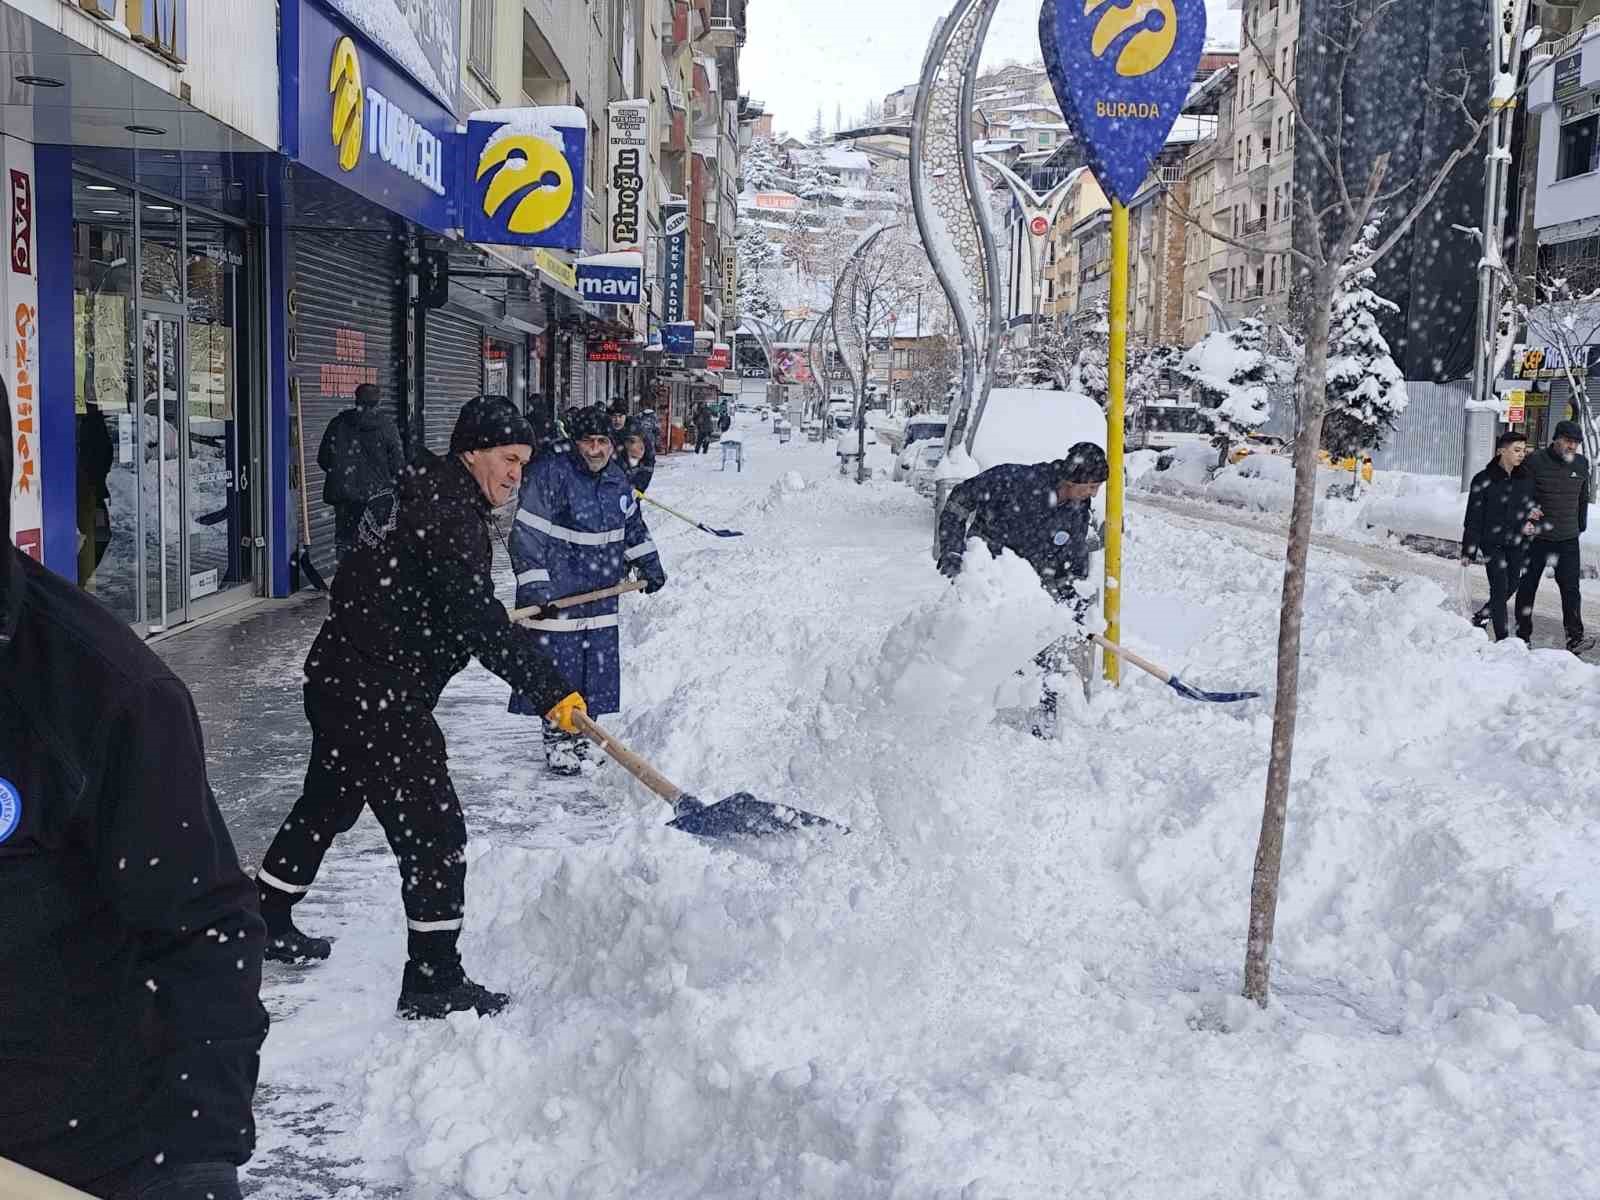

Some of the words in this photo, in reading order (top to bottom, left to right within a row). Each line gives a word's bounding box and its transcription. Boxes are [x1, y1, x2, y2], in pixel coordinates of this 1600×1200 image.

[1096, 103, 1160, 118] BURADA
[613, 149, 643, 243] Piroğlu
[671, 236, 680, 270] OKEY
[578, 276, 638, 296] mavi
[668, 272, 679, 322] SALONU
[1522, 351, 1543, 369] CEP
